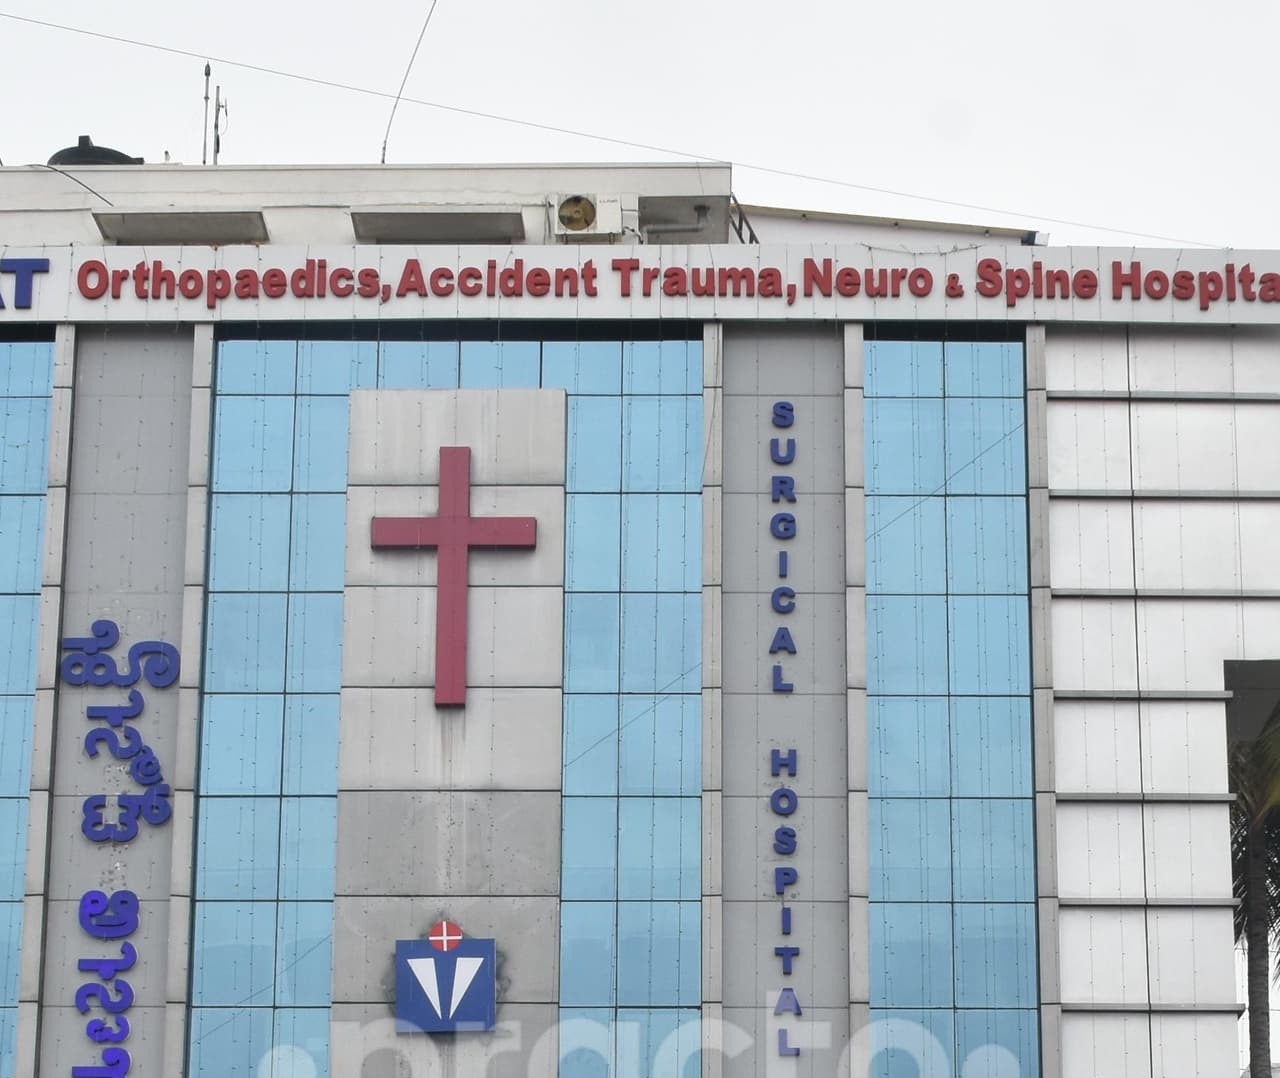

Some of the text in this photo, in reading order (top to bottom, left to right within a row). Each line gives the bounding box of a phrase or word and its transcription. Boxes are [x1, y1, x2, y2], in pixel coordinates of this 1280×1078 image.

[947, 274, 963, 296] &
[978, 259, 1098, 305] Spine
[769, 400, 803, 1058] SURGICAL HOSPITAL
